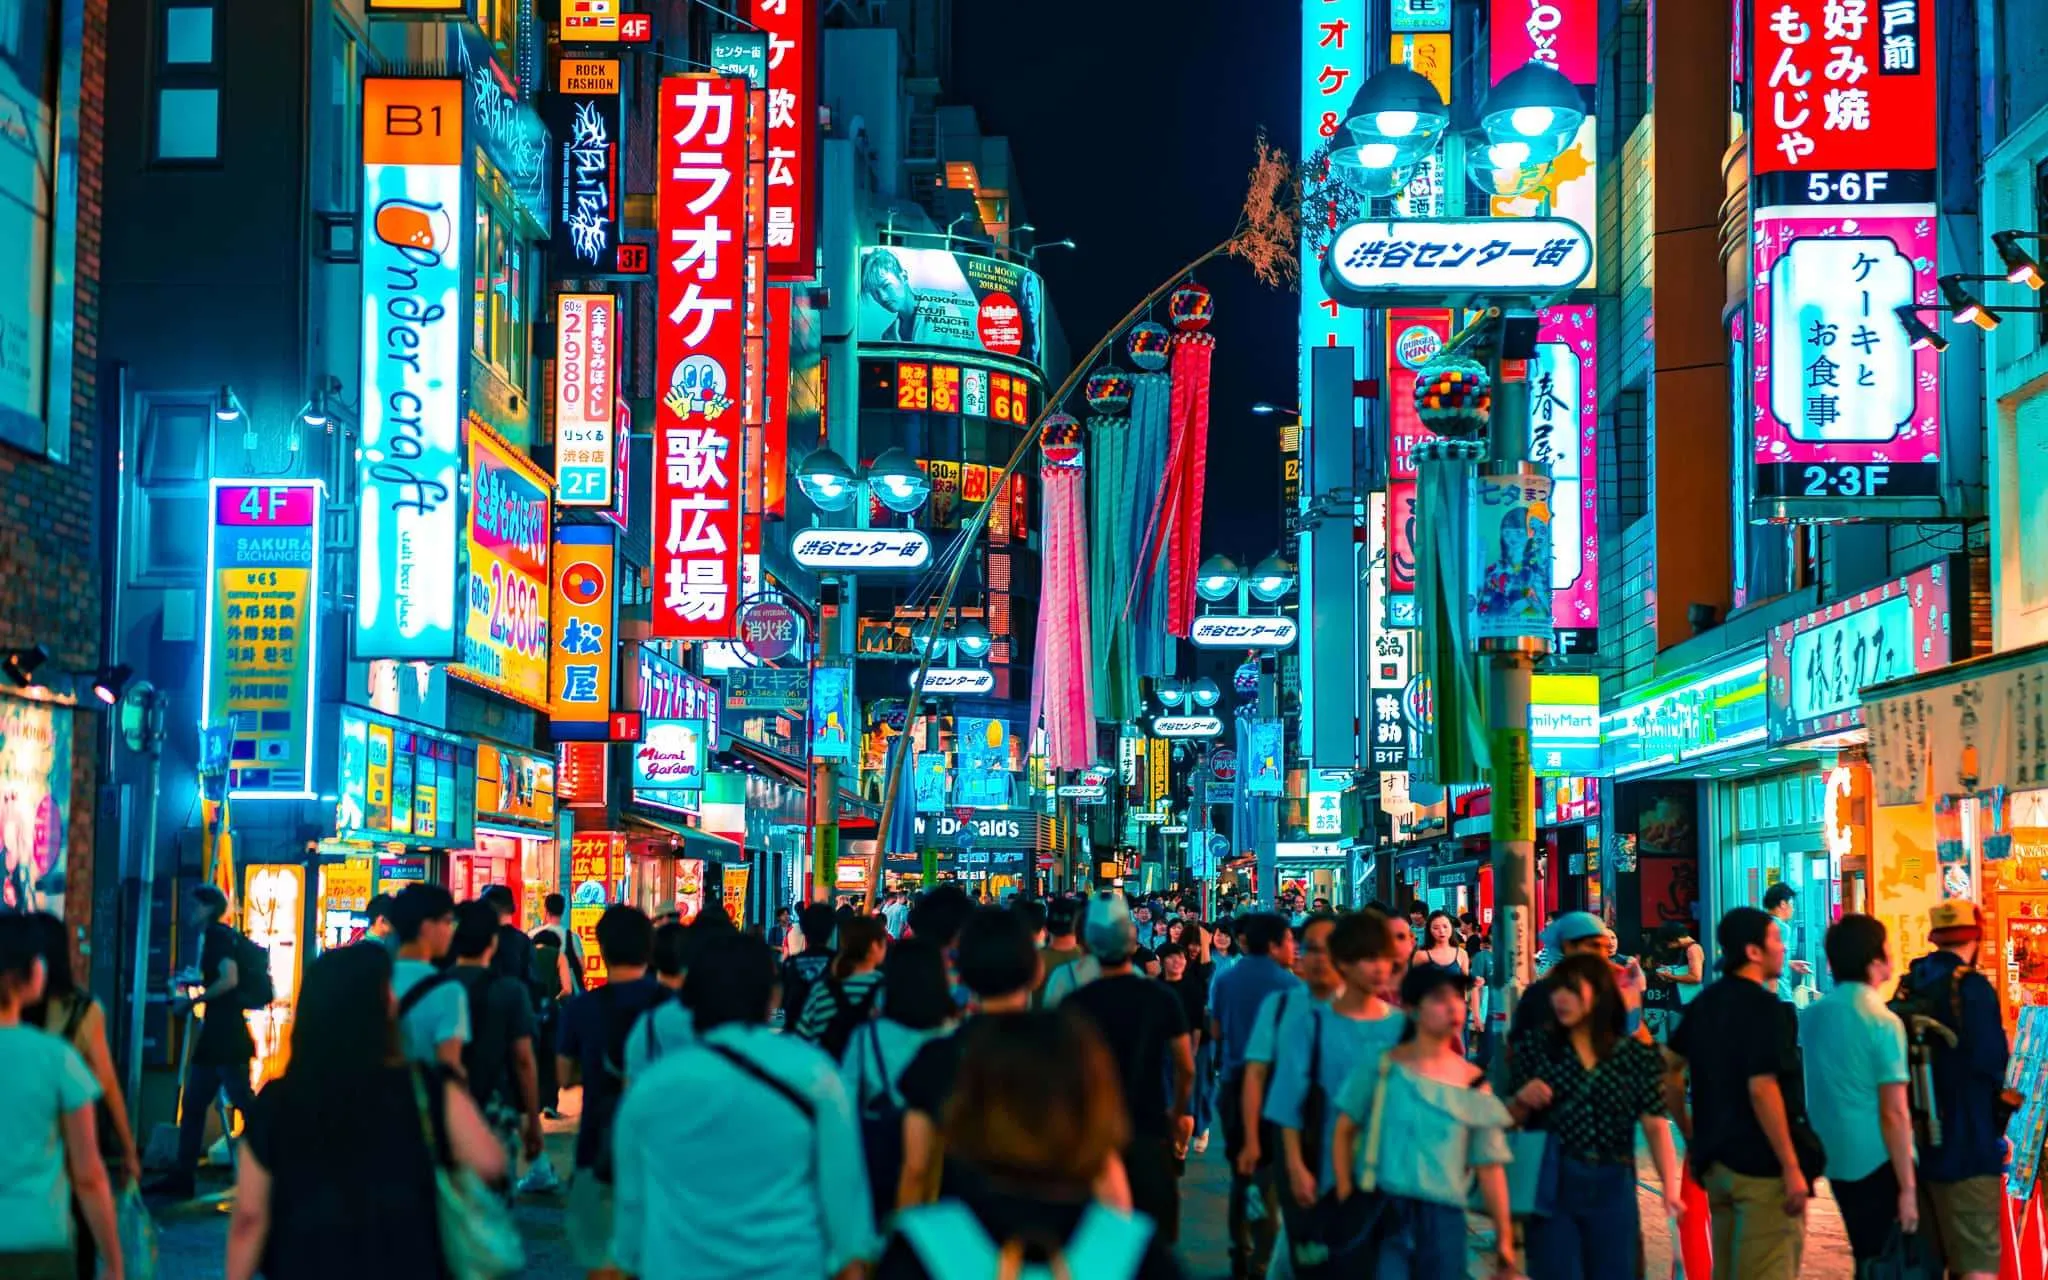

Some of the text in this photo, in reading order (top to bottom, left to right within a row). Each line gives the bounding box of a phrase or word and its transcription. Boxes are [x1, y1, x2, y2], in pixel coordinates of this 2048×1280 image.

[621, 20, 647, 36] 4F
[715, 46, 761, 58] センター街
[576, 65, 605, 76] ROCK
[568, 78, 613, 89] FASHION
[1769, 3, 1815, 165] もんじゃ
[386, 105, 442, 136] B1
[669, 81, 733, 348] カラオケ
[622, 252, 644, 268] 3F
[1344, 239, 1580, 269] 渋谷センター街
[1850, 252, 1881, 388] ケーキと
[1403, 336, 1435, 351] BURGER
[1405, 345, 1436, 361] KING
[1805, 319, 1842, 427] お食事
[564, 429, 605, 442] りらくる
[562, 450, 605, 464] 渋谷店
[568, 472, 601, 495] 2F
[240, 487, 288, 520] 4F
[664, 427, 730, 622] 歌広場
[237, 538, 311, 550] SAKURA
[799, 540, 923, 557] 渋谷センター街
[745, 619, 793, 642] 消火栓
[1197, 625, 1290, 637] 渋谷センター街
[561, 616, 603, 704] 松屋
[749, 670, 809, 690] セキネ
[913, 676, 989, 687] 谷センター街
[1157, 722, 1217, 731] 渋谷センター街
[635, 746, 686, 762] Miami
[1375, 752, 1403, 763] B1F
[645, 762, 700, 781] Garden
[1319, 795, 1337, 811] 本
